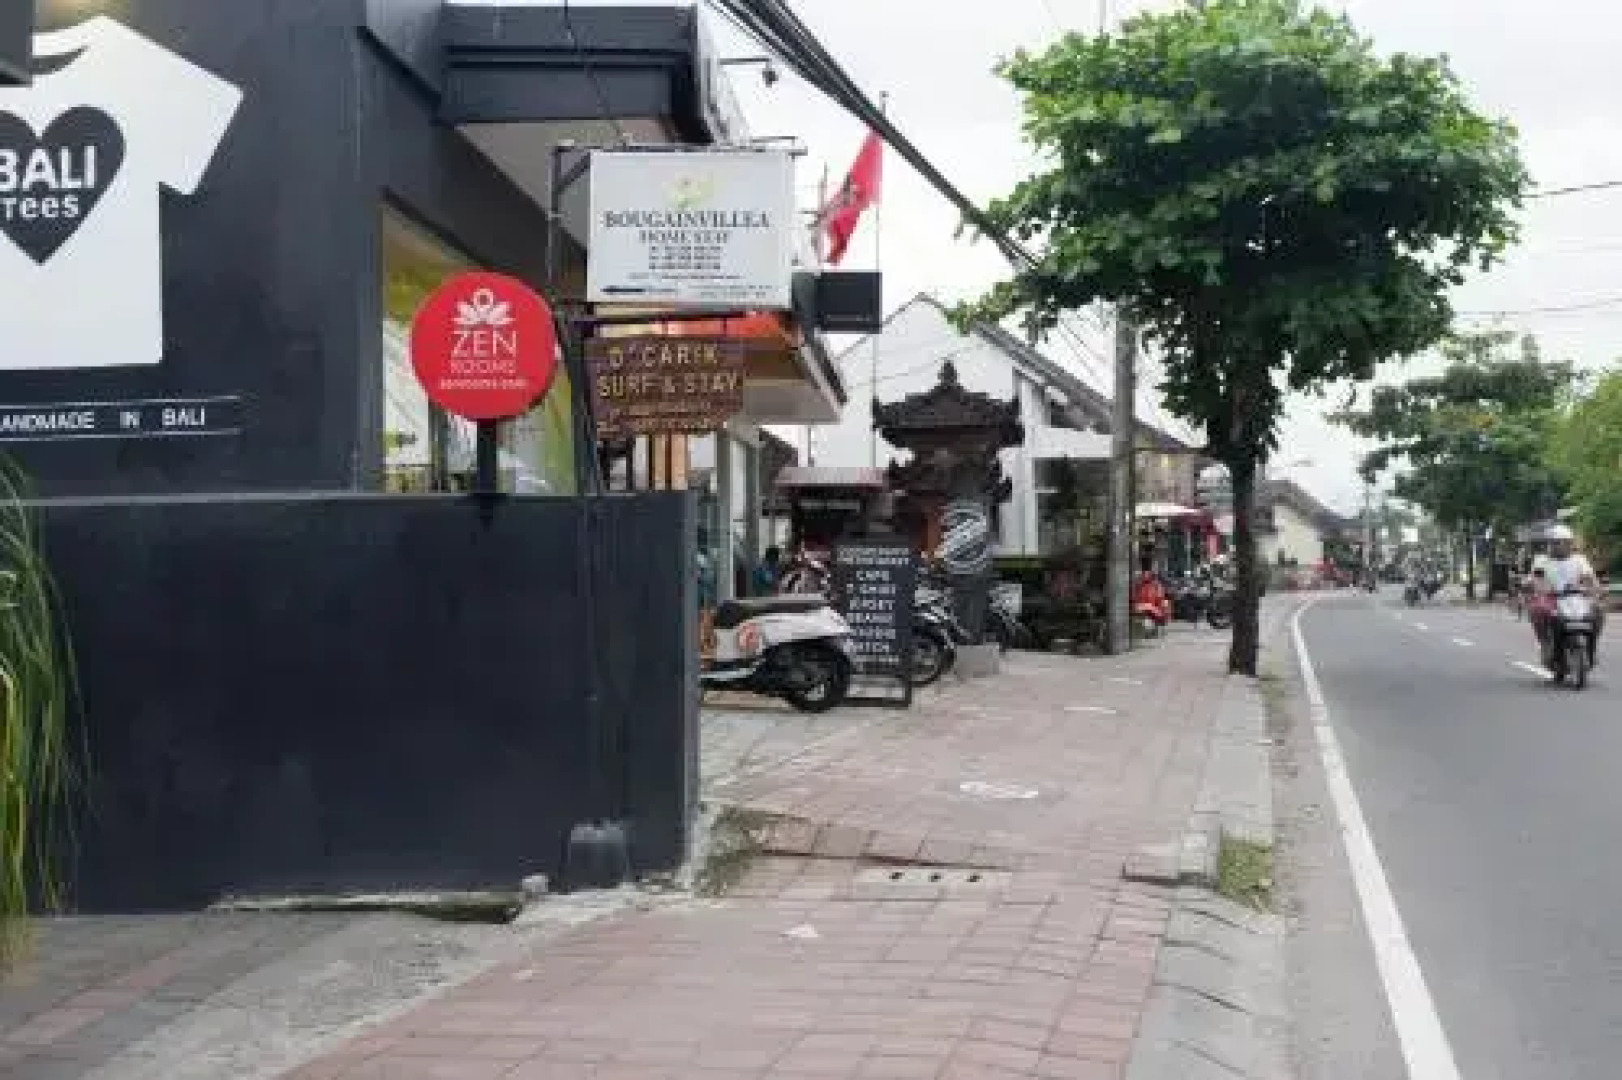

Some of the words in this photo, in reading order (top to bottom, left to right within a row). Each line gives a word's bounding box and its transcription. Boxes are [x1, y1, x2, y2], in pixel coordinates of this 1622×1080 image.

[0, 146, 95, 191] BALI
[606, 211, 770, 228] BOUGAINVILLEA
[451, 330, 517, 357] ZEN
[597, 373, 658, 397] SURF
[684, 371, 738, 393] STAY
[161, 408, 206, 426] BALI
